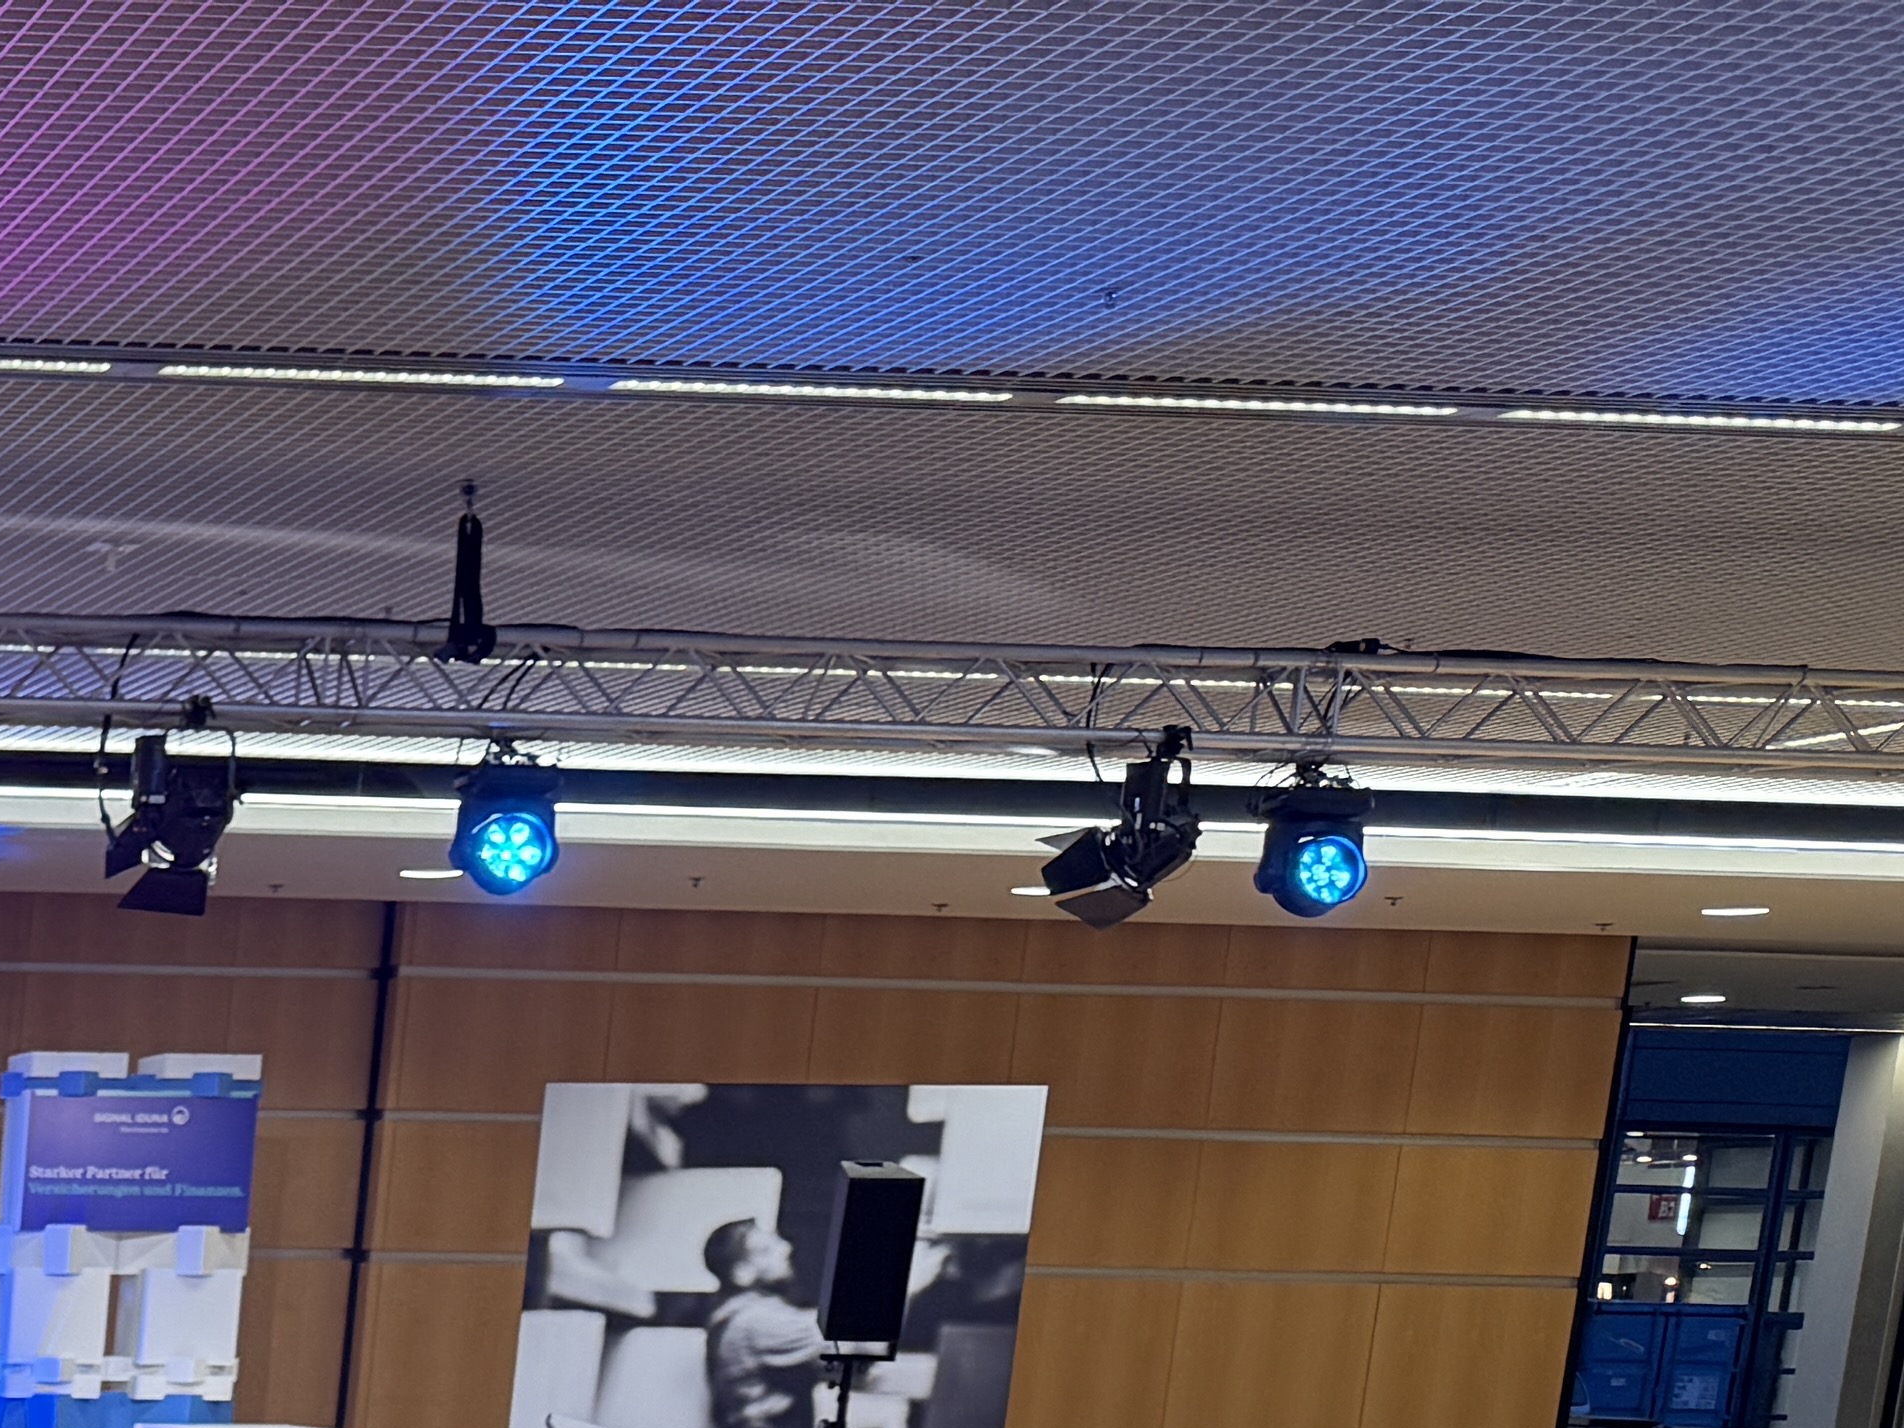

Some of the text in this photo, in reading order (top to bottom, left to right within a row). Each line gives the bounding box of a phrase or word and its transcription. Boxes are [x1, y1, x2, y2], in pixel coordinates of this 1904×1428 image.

[29, 1166, 169, 1180] Starker Partner für
